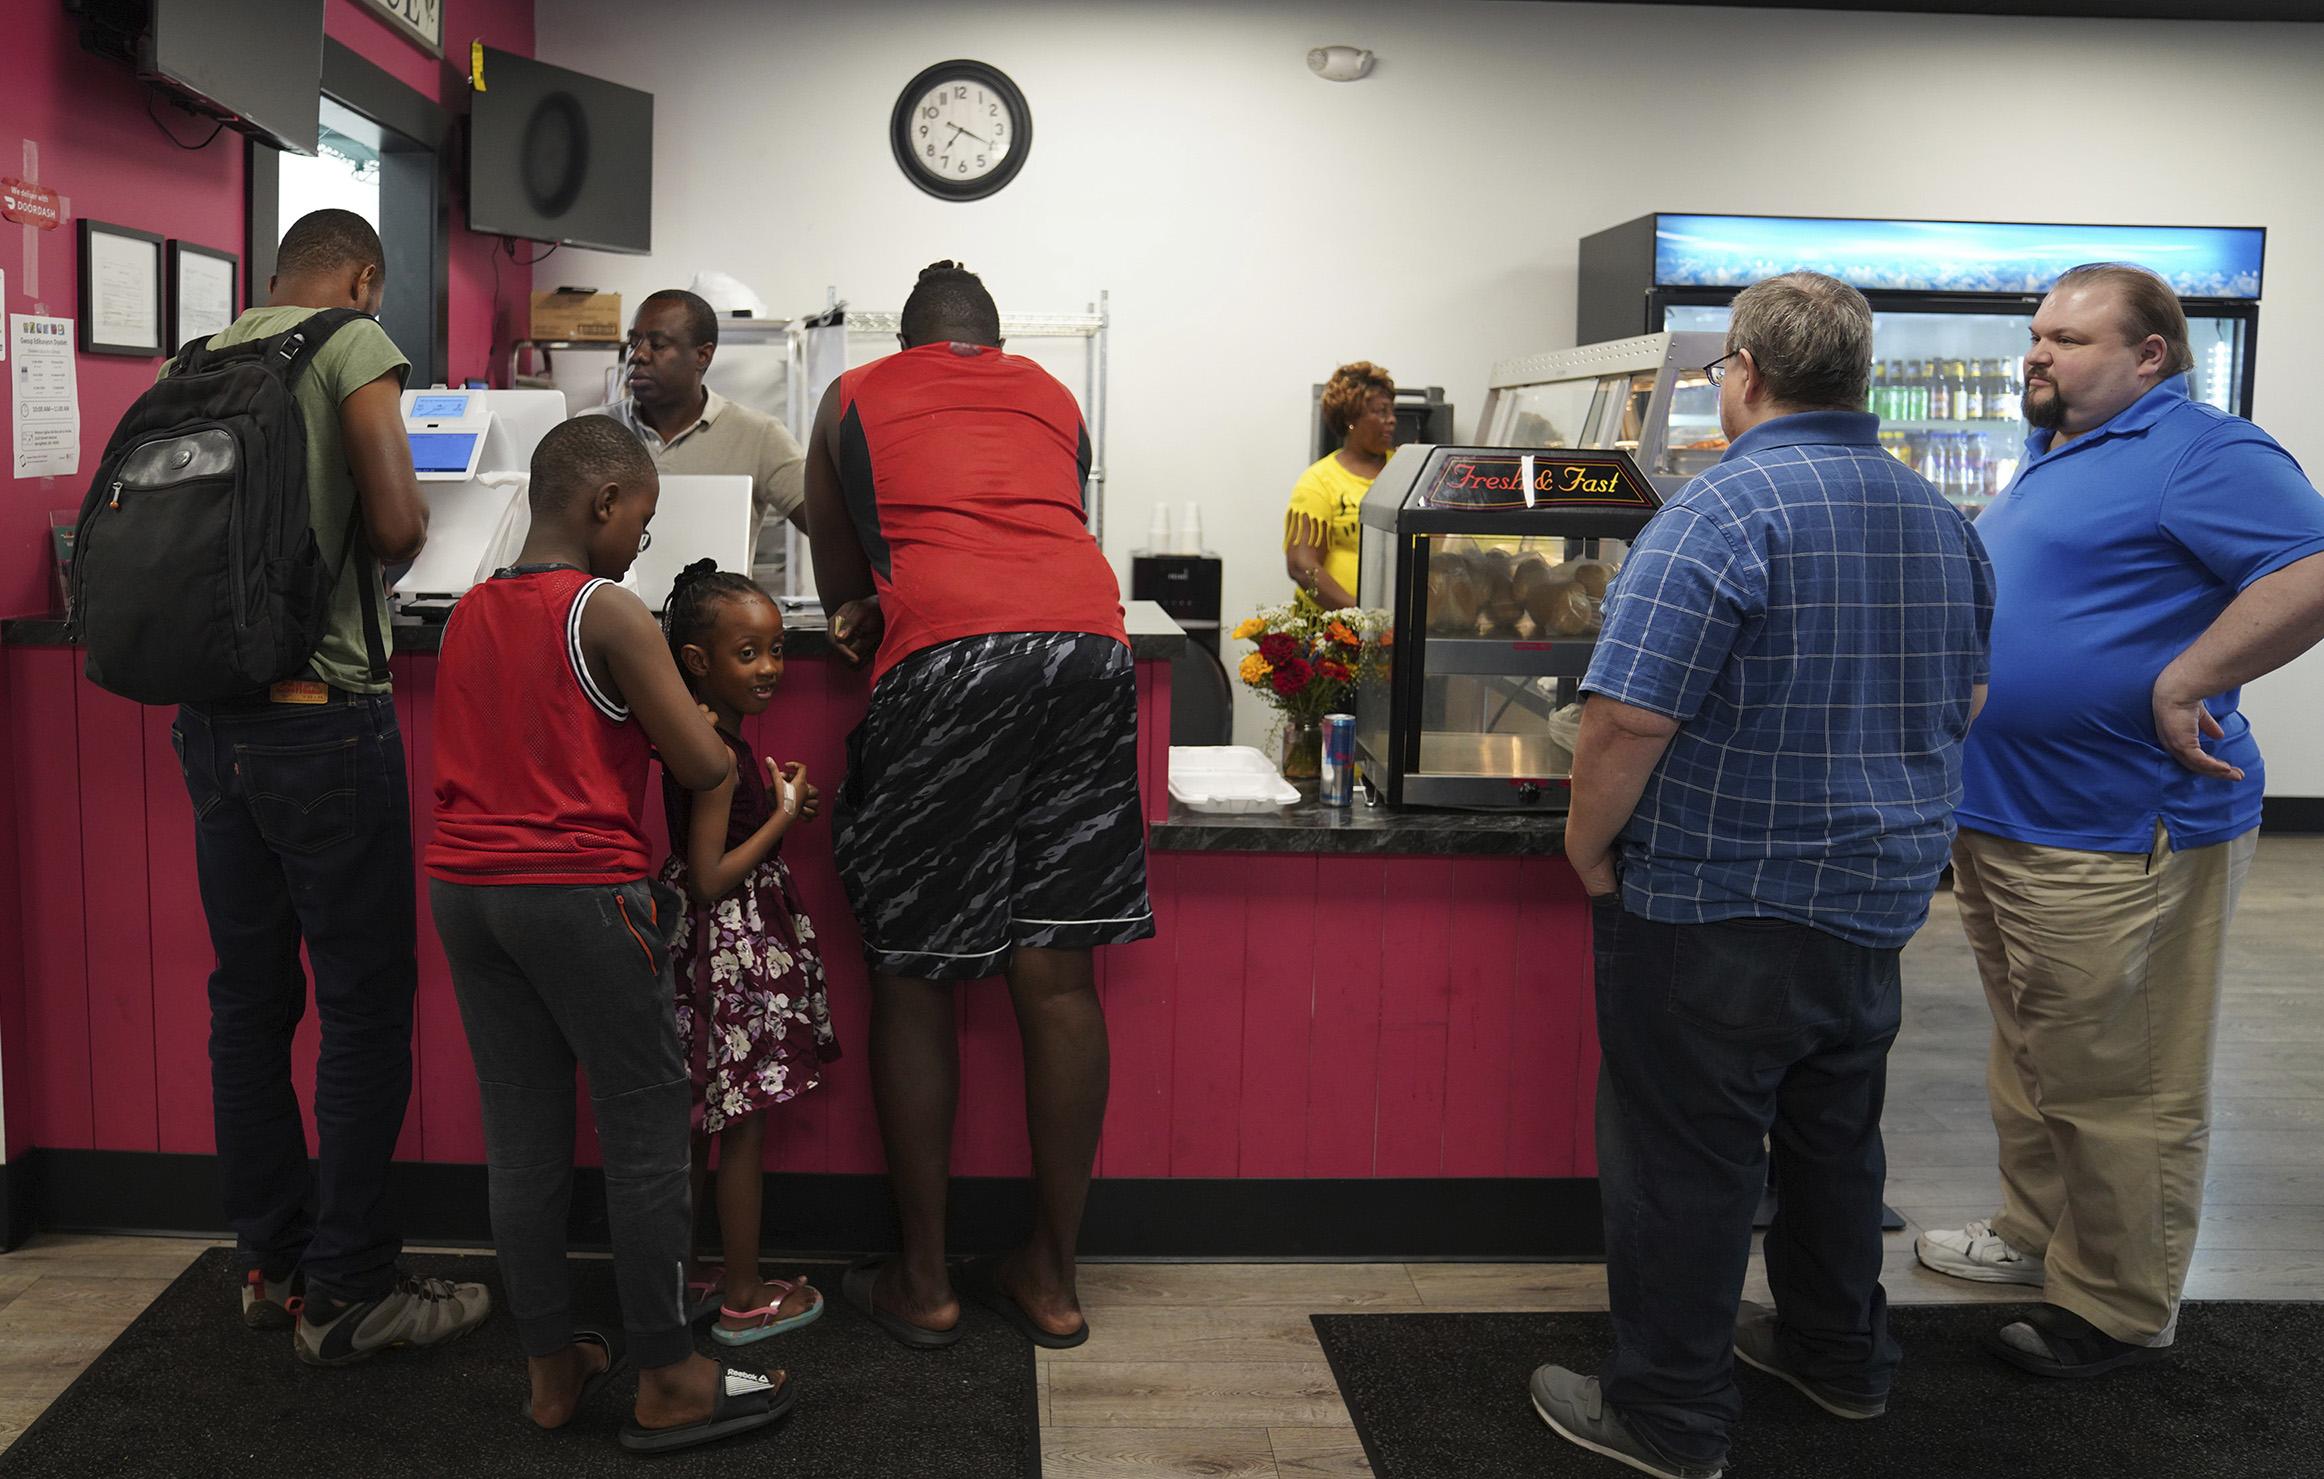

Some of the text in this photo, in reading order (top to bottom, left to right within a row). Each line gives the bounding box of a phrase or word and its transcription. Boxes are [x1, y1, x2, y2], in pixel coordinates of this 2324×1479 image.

[939, 92, 948, 105] 11
[954, 86, 967, 99] 12
[979, 91, 983, 104] 1
[922, 106, 939, 119] 10
[989, 103, 998, 117] 2
[920, 125, 929, 138] 9
[994, 123, 1004, 136] 3
[926, 144, 935, 157] 8
[940, 156, 949, 169] 7
[958, 160, 967, 173] 6
[976, 154, 986, 168] 5
[18, 201, 55, 219] DOORDASH
[1448, 464, 1618, 492] Fresh & Fast
[728, 1368, 757, 1380] Reebok
